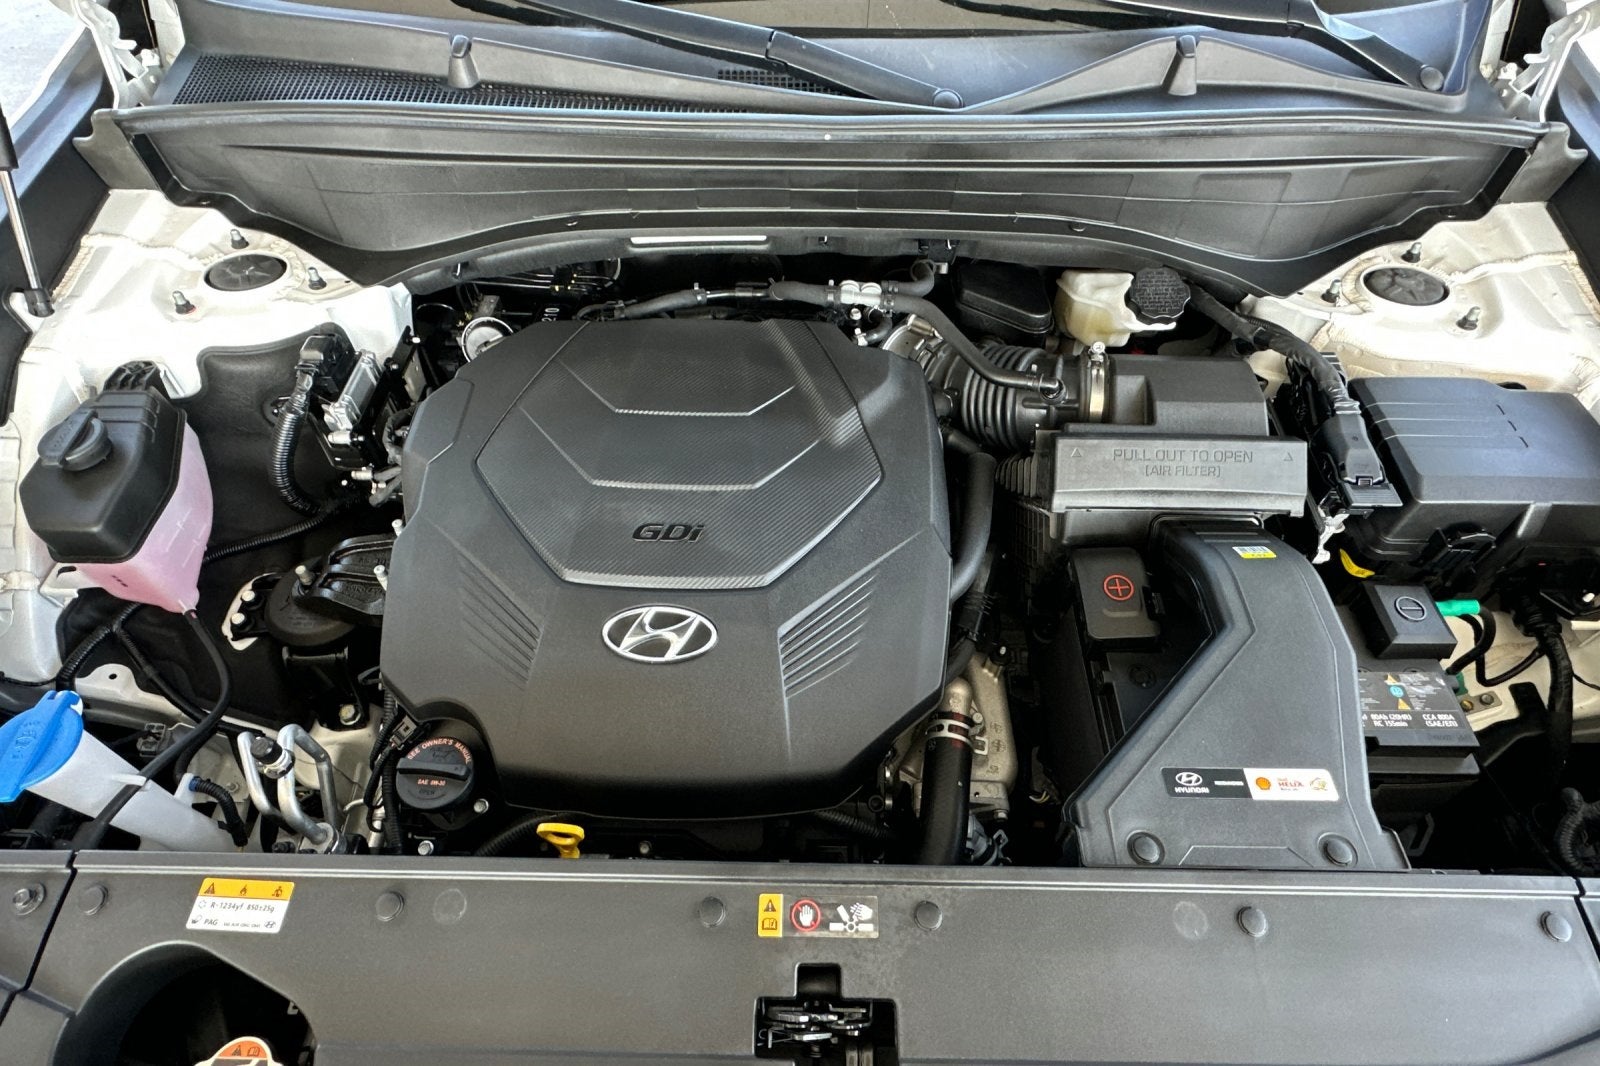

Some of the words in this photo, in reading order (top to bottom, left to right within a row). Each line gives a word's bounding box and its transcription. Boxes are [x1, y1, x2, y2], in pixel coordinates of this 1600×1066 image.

[1113, 448, 1150, 461] PULL
[1155, 449, 1186, 462] OUT
[1191, 449, 1210, 462] TO
[1213, 450, 1253, 463] OPEN
[632, 523, 705, 542] GDi
[407, 747, 421, 760] SEE
[421, 738, 454, 750] OWNER'S
[454, 742, 472, 765] MANUAL
[1174, 786, 1210, 794] HYUNDAI
[203, 918, 218, 926] PAG
